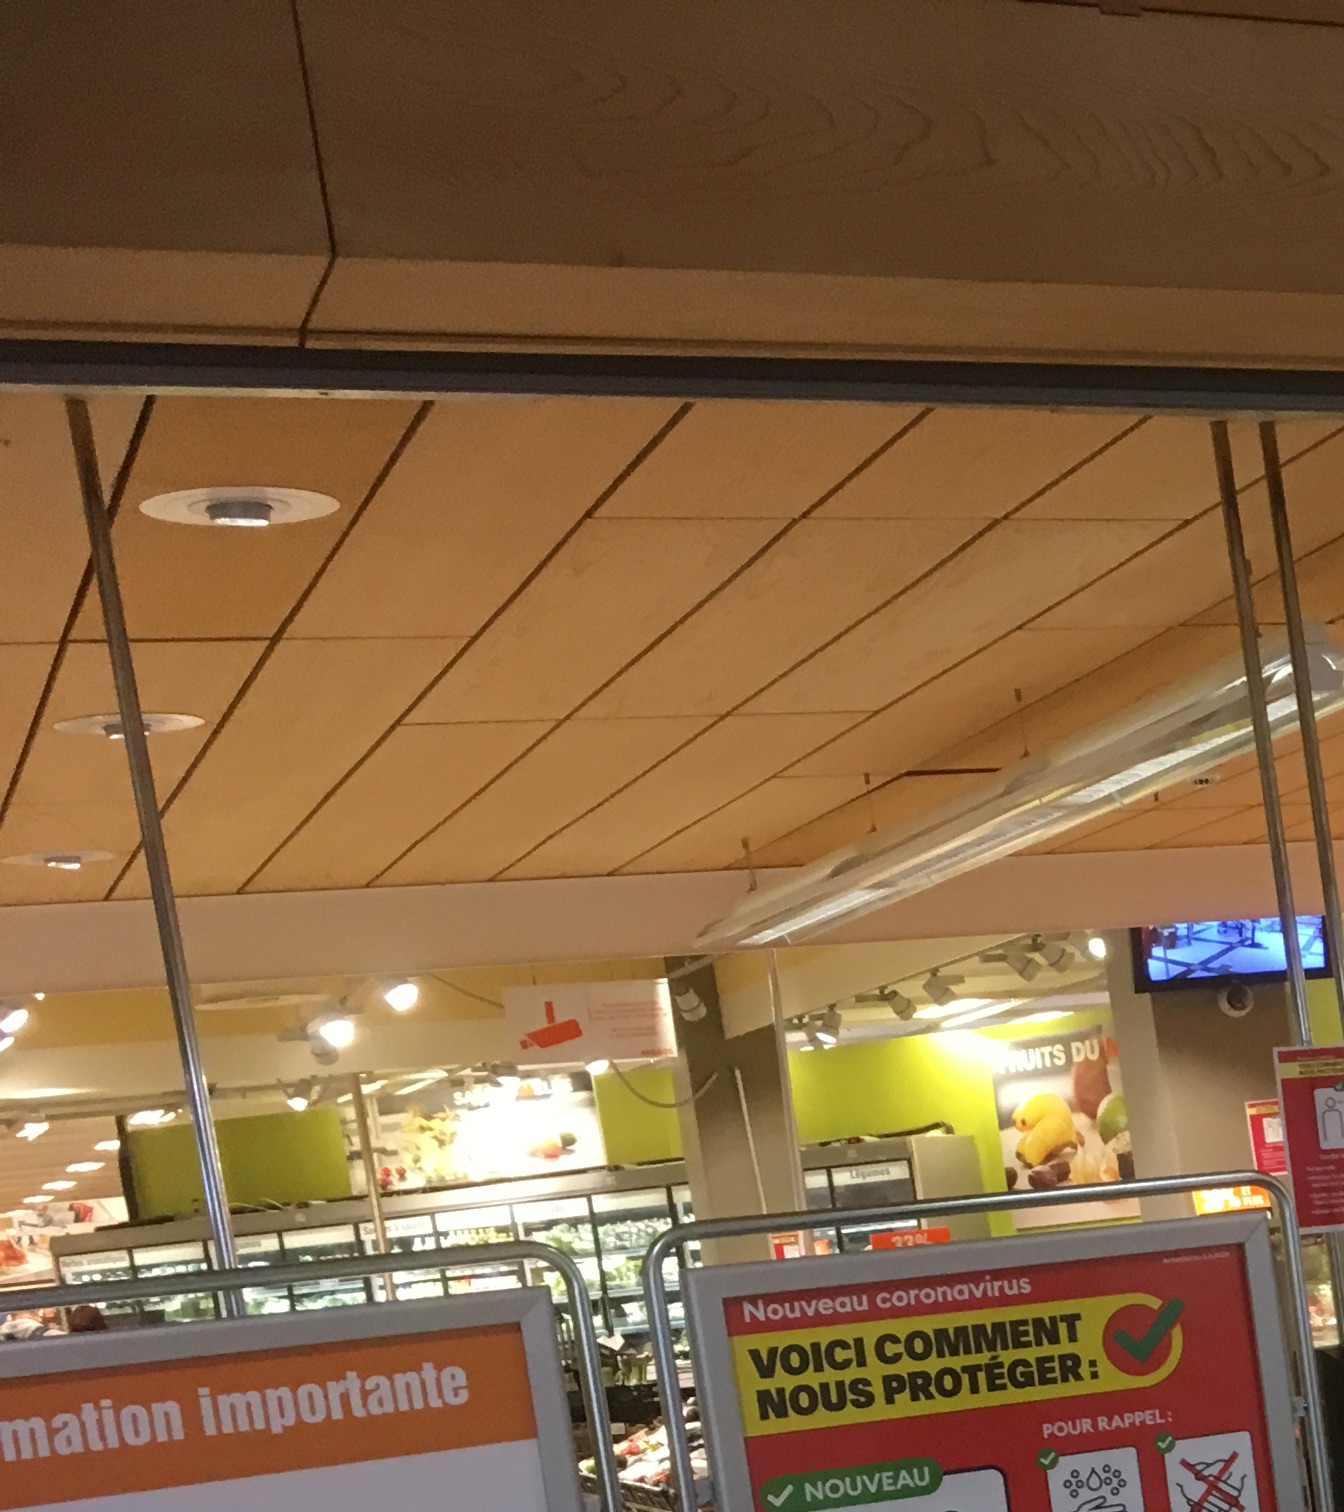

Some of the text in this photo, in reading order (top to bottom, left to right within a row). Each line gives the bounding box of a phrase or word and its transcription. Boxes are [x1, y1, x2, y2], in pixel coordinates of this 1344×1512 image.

[1070, 1038, 1100, 1063] DU
[742, 1274, 1032, 1324] Nouveau coronavirus
[747, 1312, 1083, 1380] VOICI COMMENT
[0, 1362, 470, 1463] mation importante
[756, 1378, 877, 1422] NOUS
[1043, 1417, 1094, 1438] POUR
[804, 1467, 930, 1503] NOUVEAU
